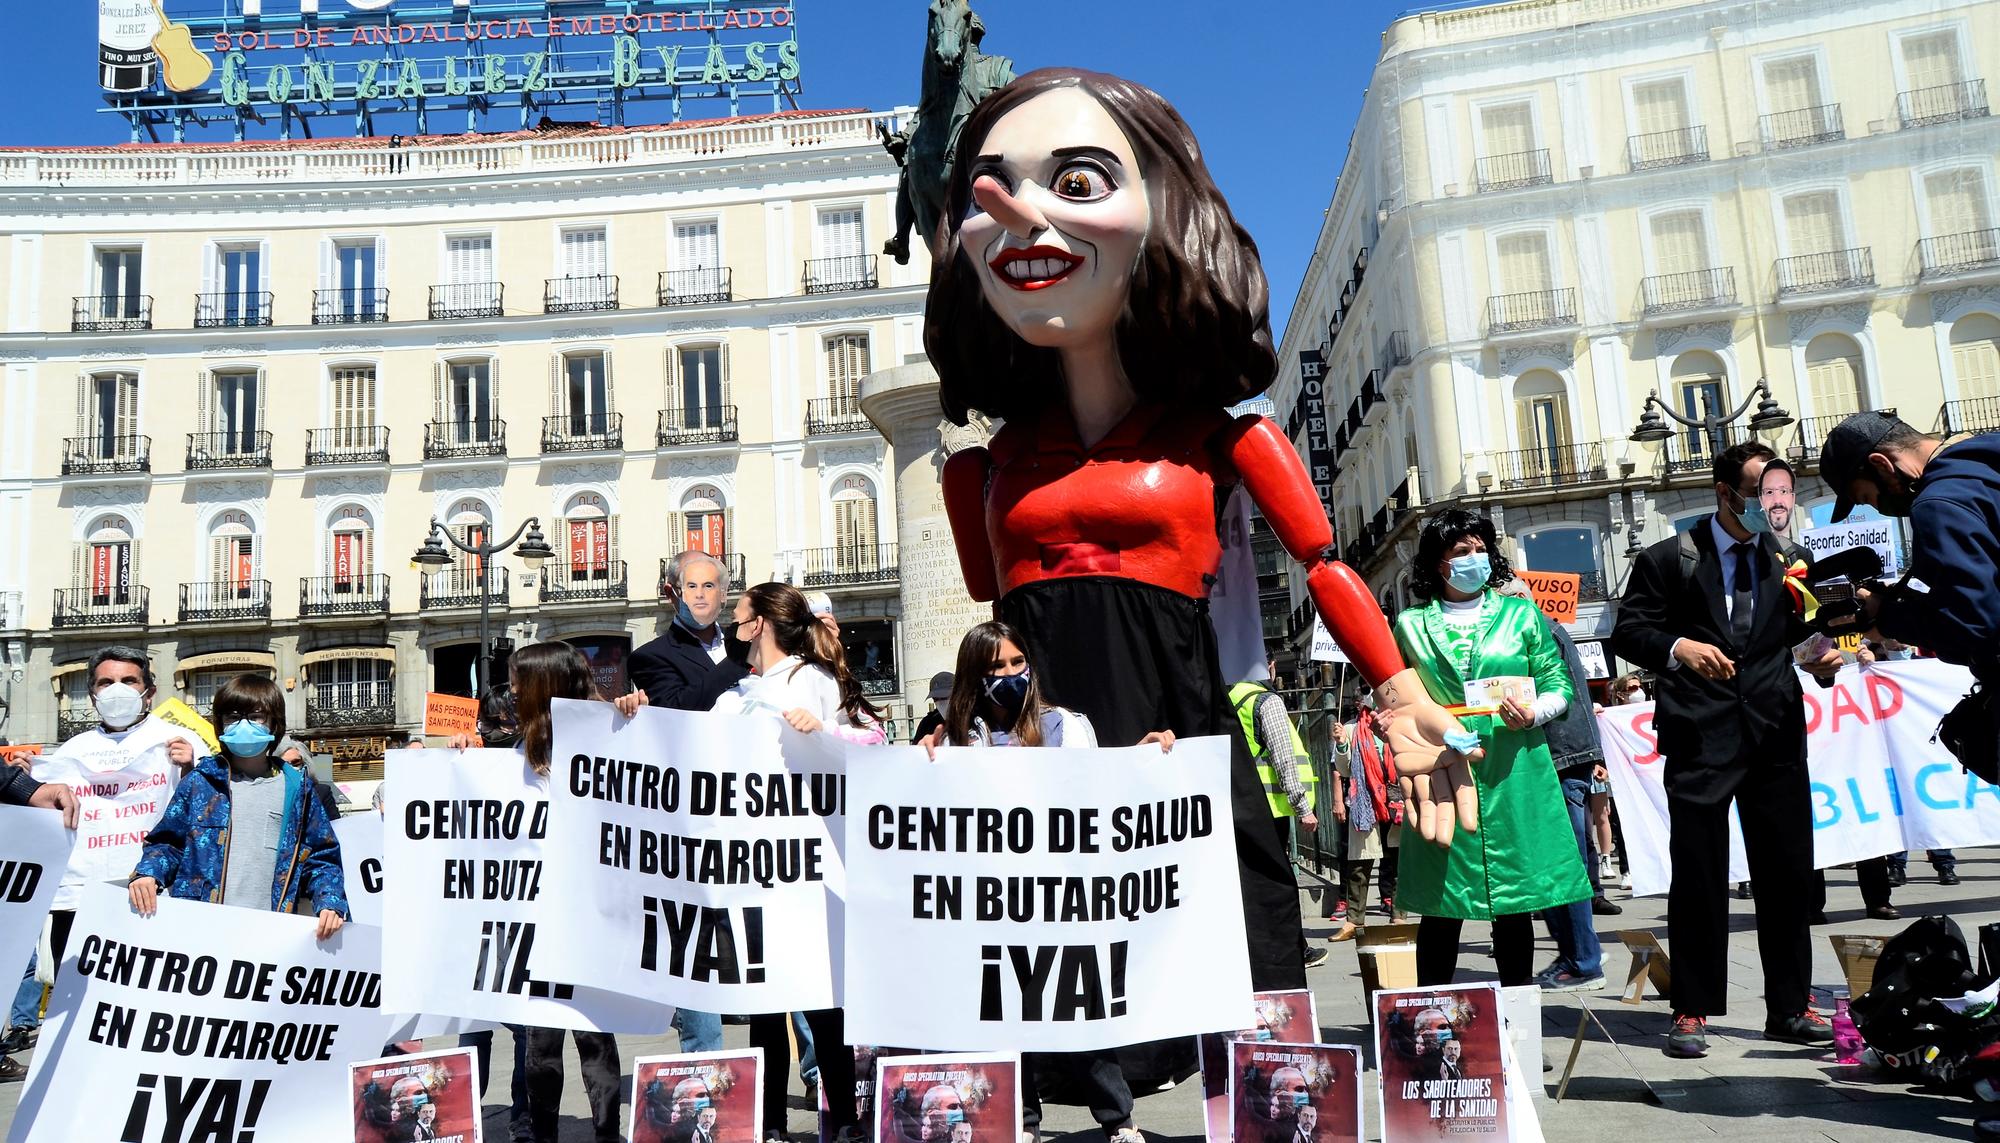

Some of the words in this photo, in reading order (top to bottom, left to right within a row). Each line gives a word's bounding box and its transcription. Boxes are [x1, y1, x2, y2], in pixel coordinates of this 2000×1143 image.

[115, 24, 146, 34] JEREZ
[214, 31, 281, 51] SOL
[294, 27, 335, 48] DE
[351, 18, 534, 46] ANDALUCIA
[550, 7, 791, 37] EMBOTELLADO
[105, 52, 123, 62] FINO
[219, 50, 548, 106] GONZALEZ
[613, 35, 799, 88] BYASS
[1302, 362, 1327, 451] HOTEL
[338, 535, 347, 583] LEARN
[572, 525, 587, 564] 学习
[1803, 533, 1845, 551] Recortar
[1847, 527, 1890, 547] Sanidad,
[98, 546, 106, 596] APRENDE
[1522, 577, 1576, 597] YUSO,
[1534, 598, 1575, 614] USO!
[201, 656, 251, 665] FORNITURAS
[319, 650, 380, 659] HERRAMIENTAS
[444, 704, 476, 719] PERSONAL
[570, 753, 681, 814] CENTRO
[690, 770, 738, 817] DE
[83, 808, 102, 822] SE
[114, 801, 158, 818] VENDE
[405, 799, 525, 840] CENTRO
[528, 801, 549, 840] D
[868, 804, 1034, 854] CENTRO
[1048, 808, 1100, 854] DE
[1112, 794, 1213, 853] SALUD
[600, 821, 632, 871] EN
[640, 834, 824, 888] BUTARQUE
[443, 859, 475, 900] EN
[482, 859, 543, 901] BUTA
[912, 874, 962, 920] EN
[976, 864, 1180, 923] BUTARQUE
[640, 896, 767, 985] ¡YA!
[77, 934, 218, 997] CENTRO
[224, 959, 278, 1003] DE
[280, 965, 382, 1009] SALUD
[979, 940, 1129, 1022] ¡YA!
[88, 1001, 137, 1050] EN
[141, 1011, 339, 1065] BUTARQUE
[119, 1073, 273, 1143] ¡YA!
[1402, 1080, 1420, 1100] LOS
[1423, 1078, 1492, 1099] SABOTEADORES
[1430, 1100, 1442, 1118] DE
[1445, 1100, 1457, 1118] LA
[1459, 1099, 1498, 1118] SANIDAD
